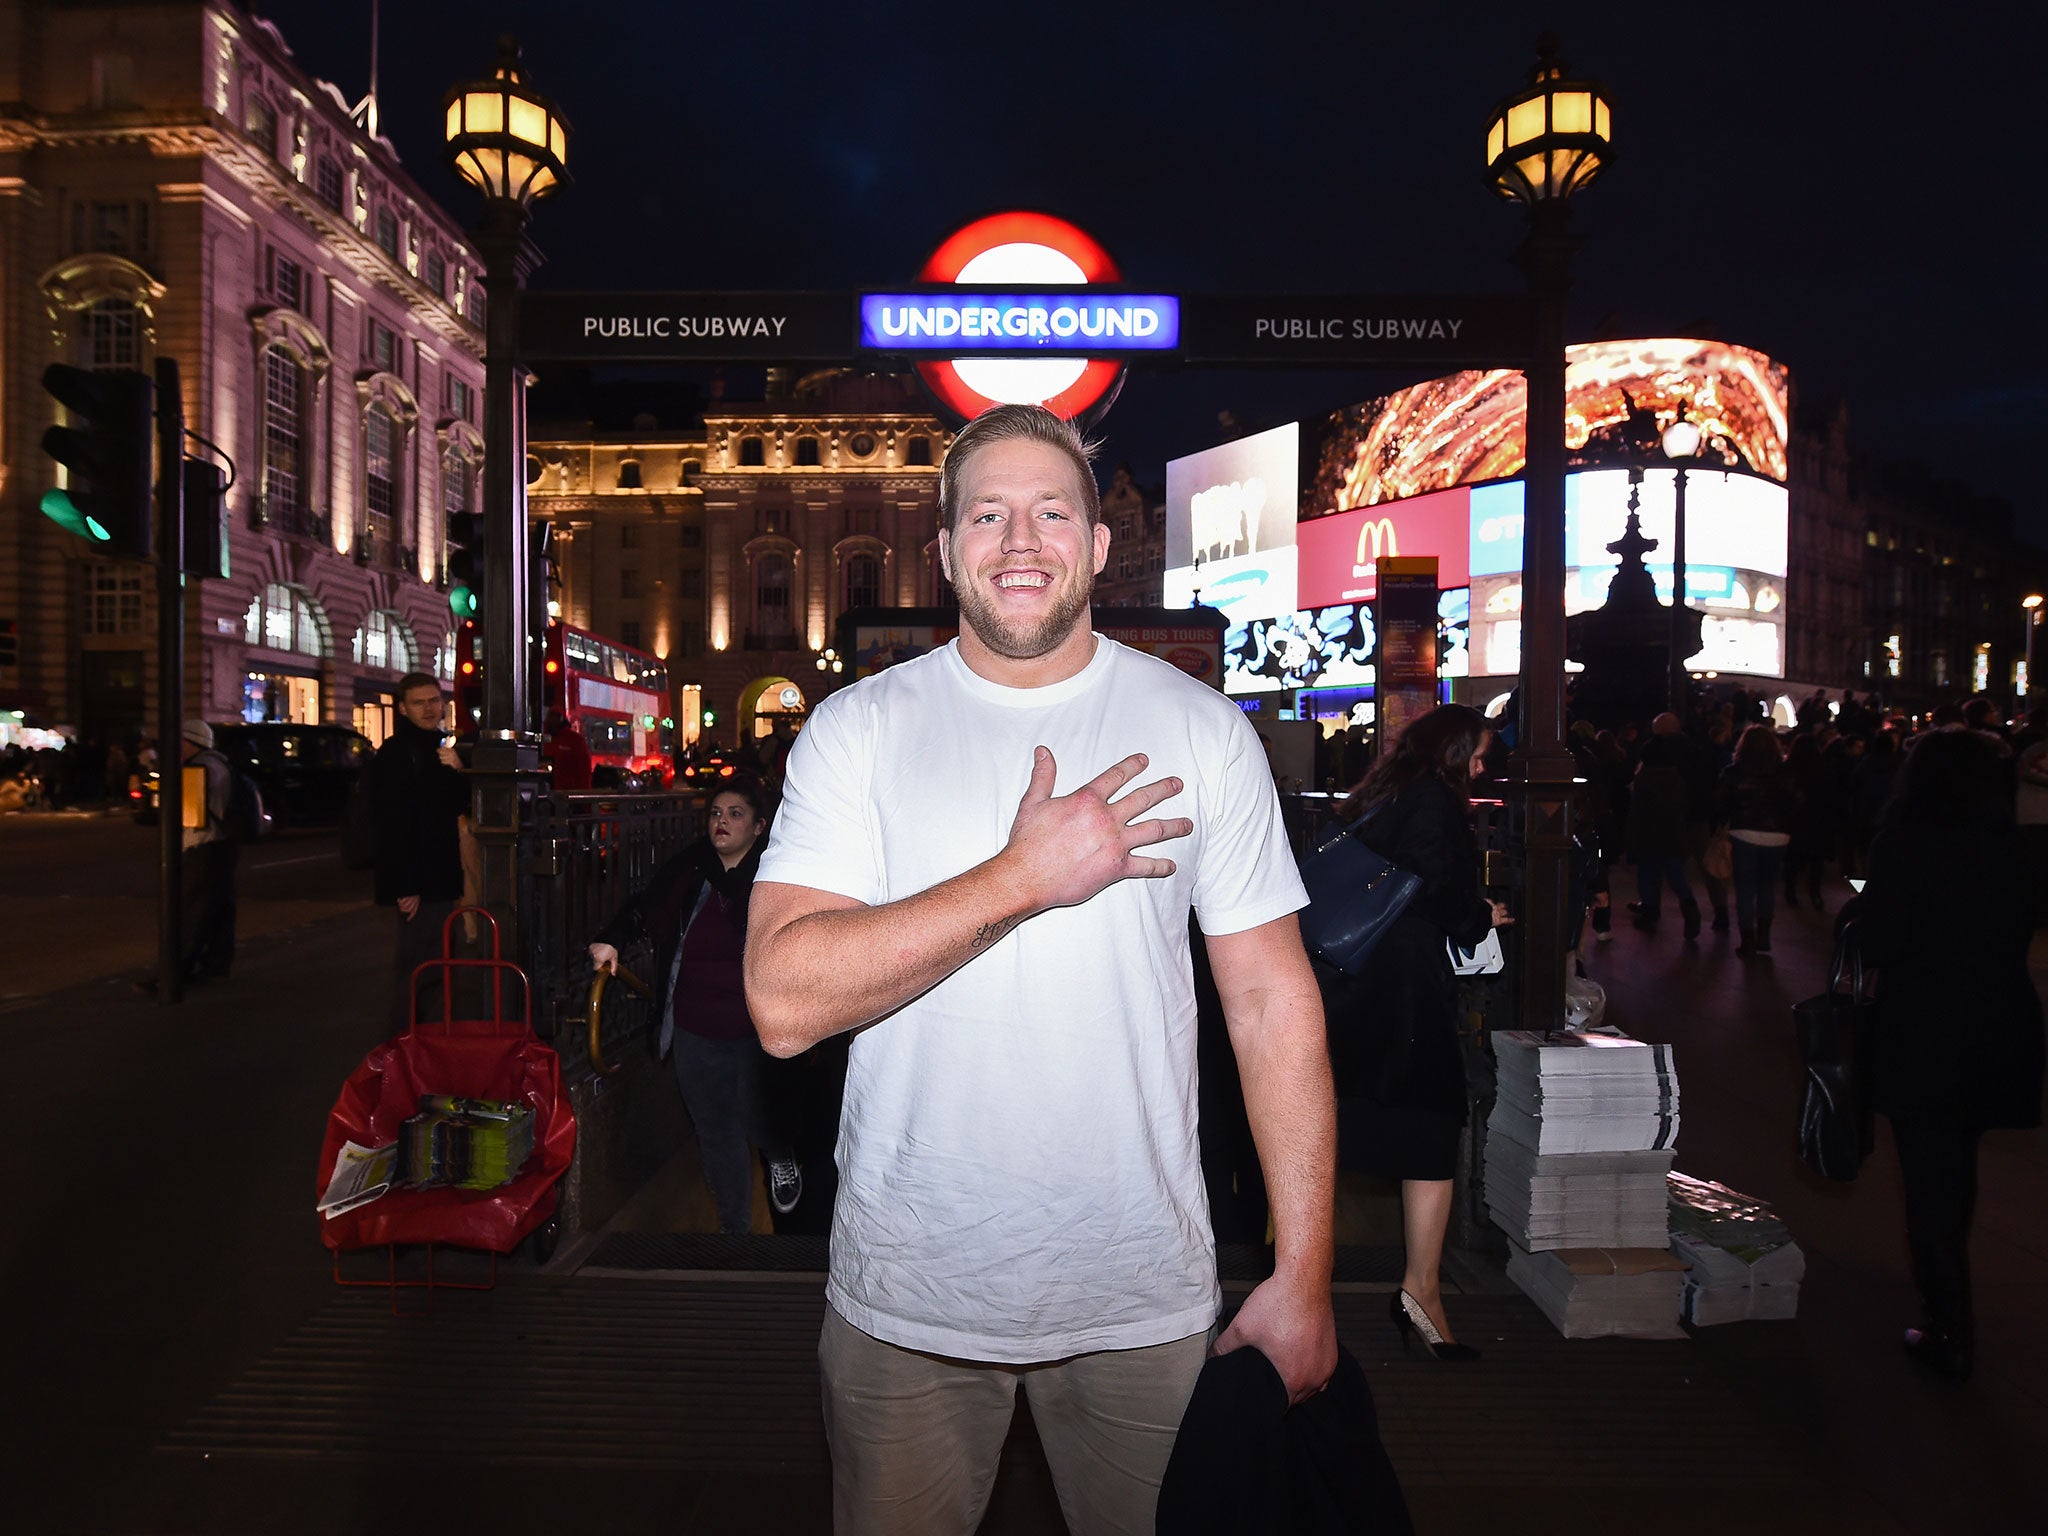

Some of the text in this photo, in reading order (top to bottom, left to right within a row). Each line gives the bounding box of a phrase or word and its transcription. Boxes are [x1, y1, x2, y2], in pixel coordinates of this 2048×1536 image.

[583, 316, 787, 338] PUBLIC SUBWAY
[881, 306, 1159, 338] UNDERGROUND
[1255, 318, 1463, 339] PUBLIC SUBWAY
[1142, 628, 1168, 641] BUS
[1172, 628, 1214, 641] TOURS
